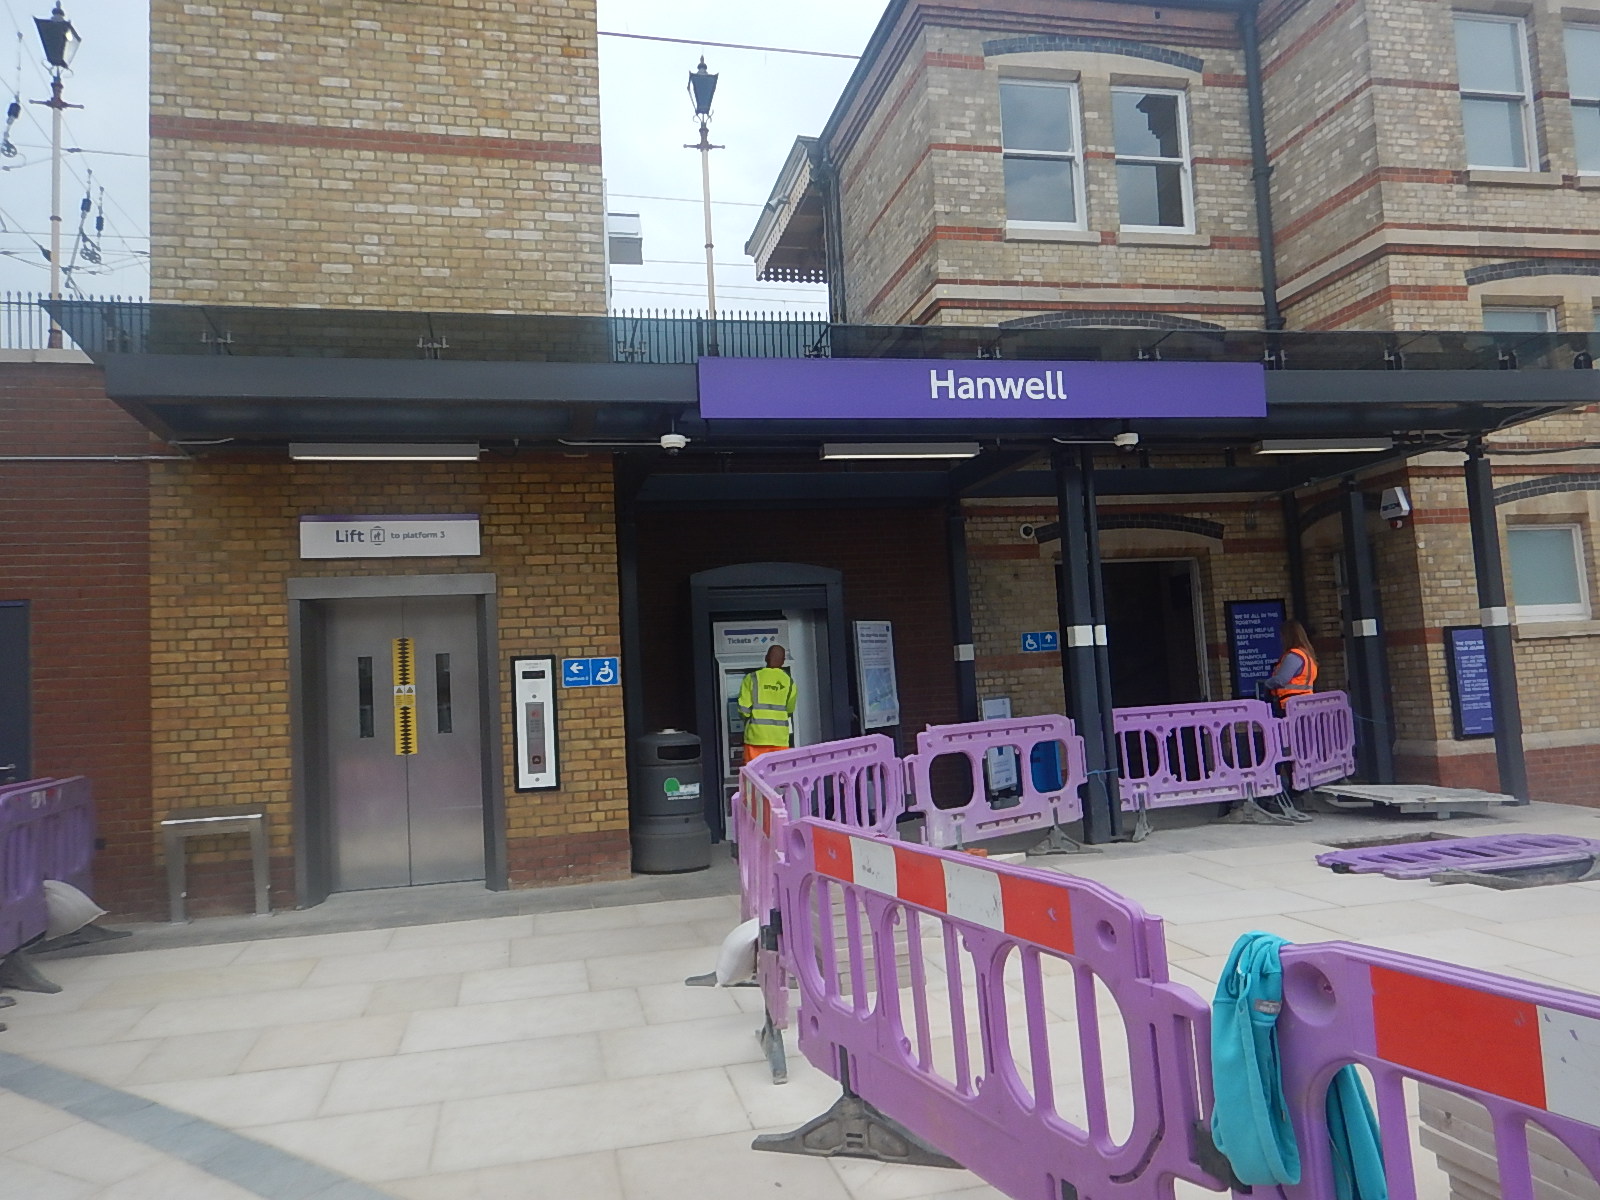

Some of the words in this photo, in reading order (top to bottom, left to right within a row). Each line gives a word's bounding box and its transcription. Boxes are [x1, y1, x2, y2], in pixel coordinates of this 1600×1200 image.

[930, 369, 1068, 400] Hanwell
[335, 529, 365, 543] Lift
[402, 530, 438, 540] platform
[440, 531, 446, 539] 3
